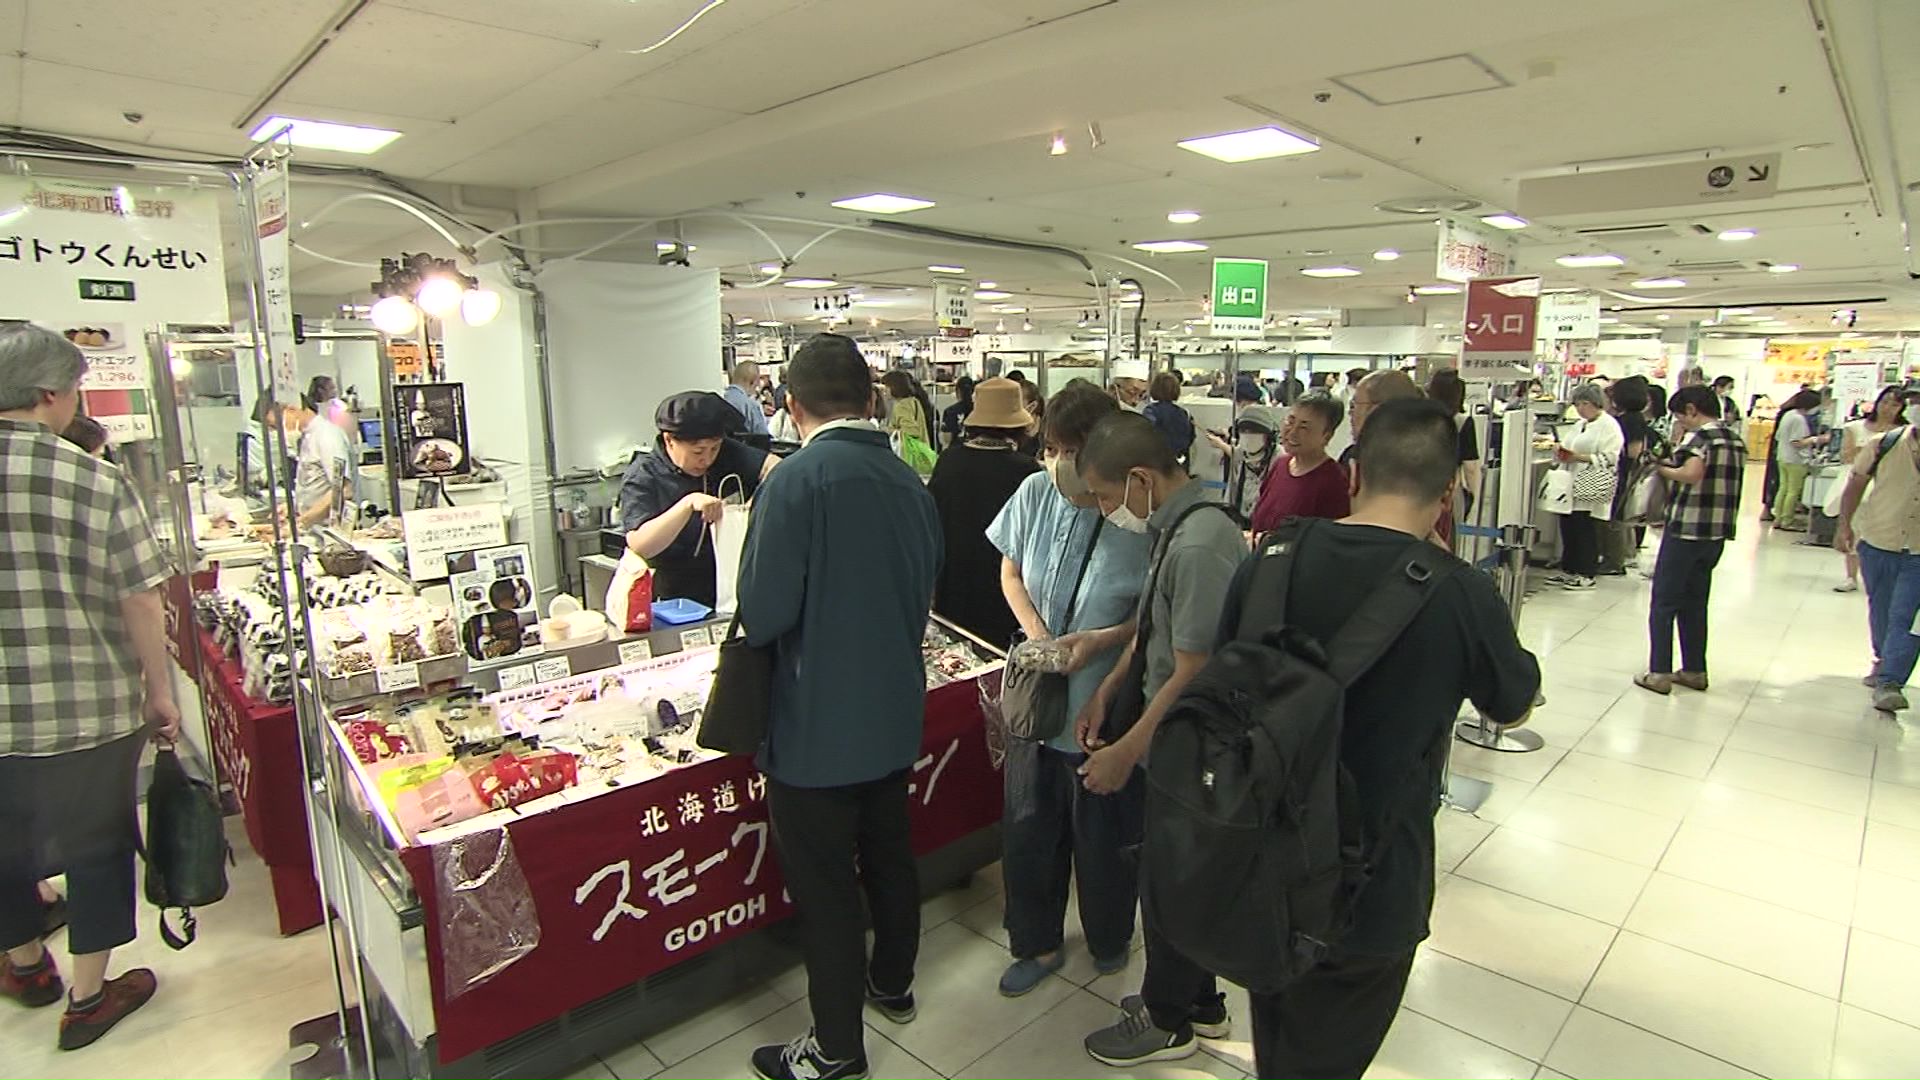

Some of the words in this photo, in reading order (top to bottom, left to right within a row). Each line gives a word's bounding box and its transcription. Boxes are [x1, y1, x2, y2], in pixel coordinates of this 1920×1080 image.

[0, 236, 207, 269] ゴトウくんせい
[1222, 286, 1257, 305] 出口
[1476, 313, 1524, 335] 入口
[664, 893, 766, 951] GOTOH
